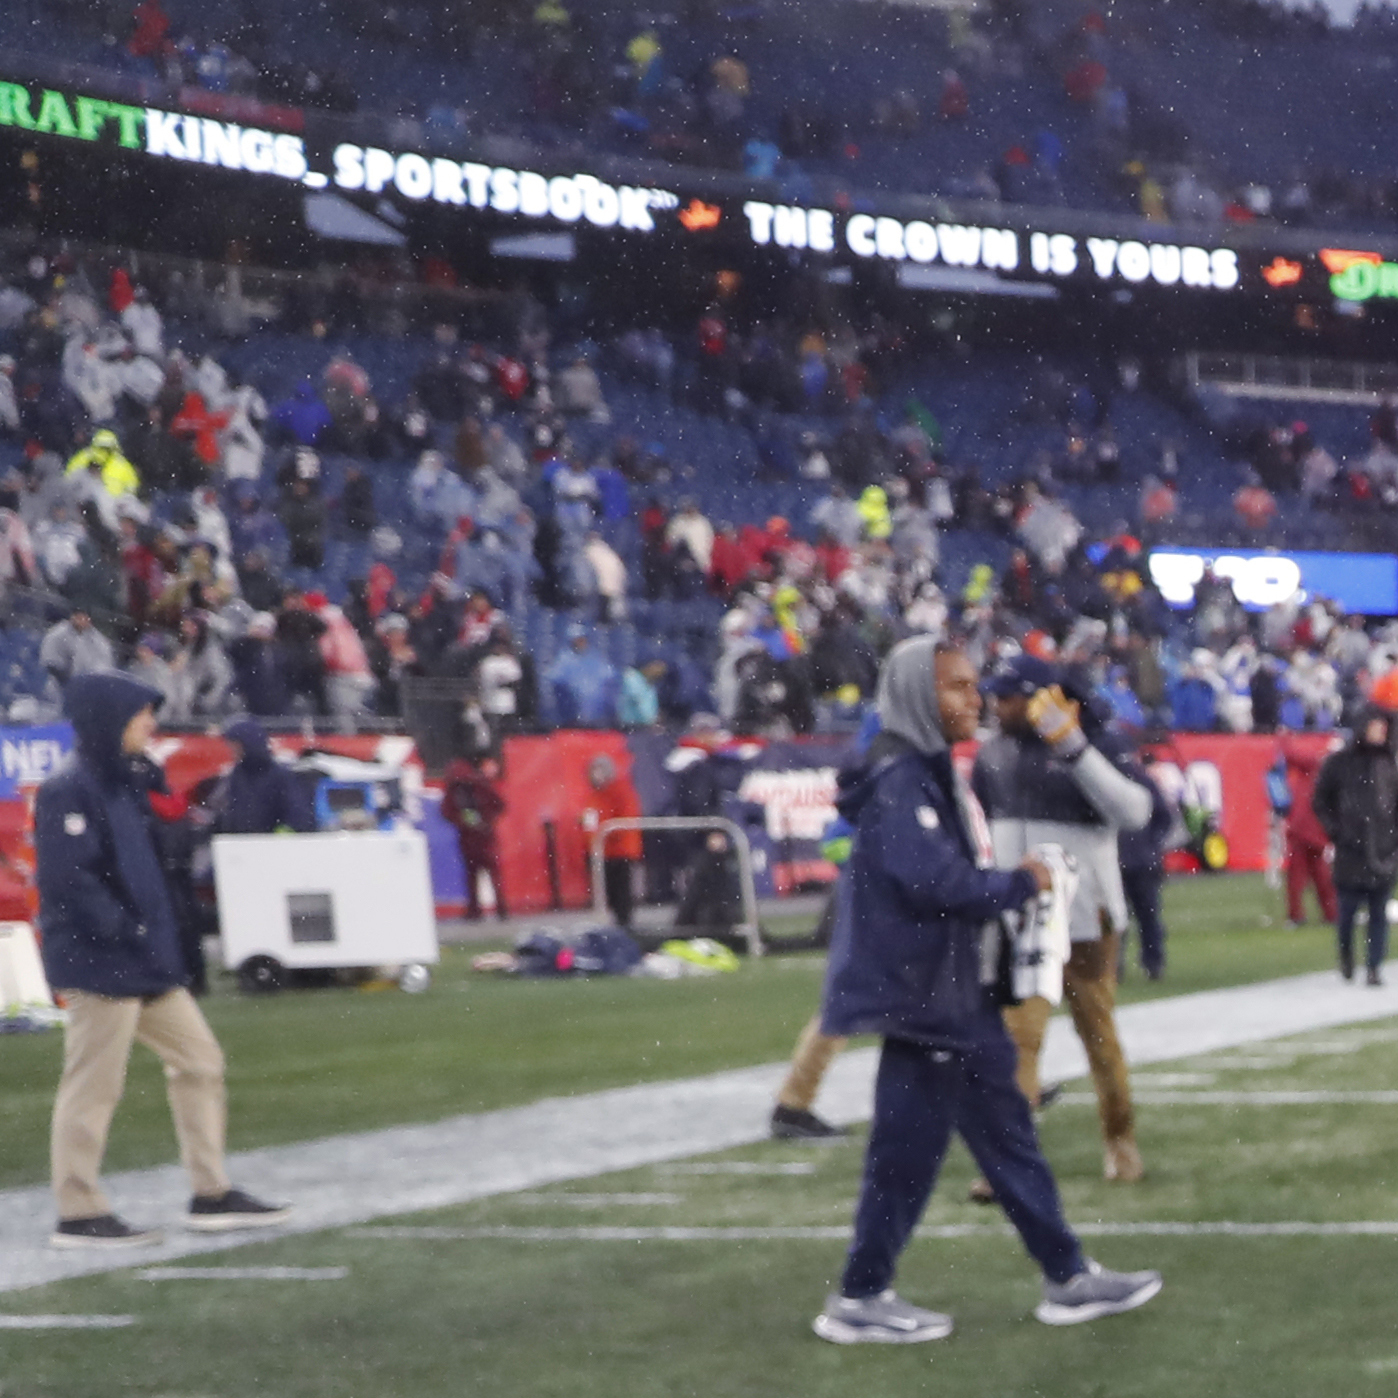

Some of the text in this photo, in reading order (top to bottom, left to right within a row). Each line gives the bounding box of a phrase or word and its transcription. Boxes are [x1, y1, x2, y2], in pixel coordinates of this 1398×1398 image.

[334, 144, 655, 230] SPORTSBOOK
[746, 202, 1238, 287] THE CROWN IS YOURS
